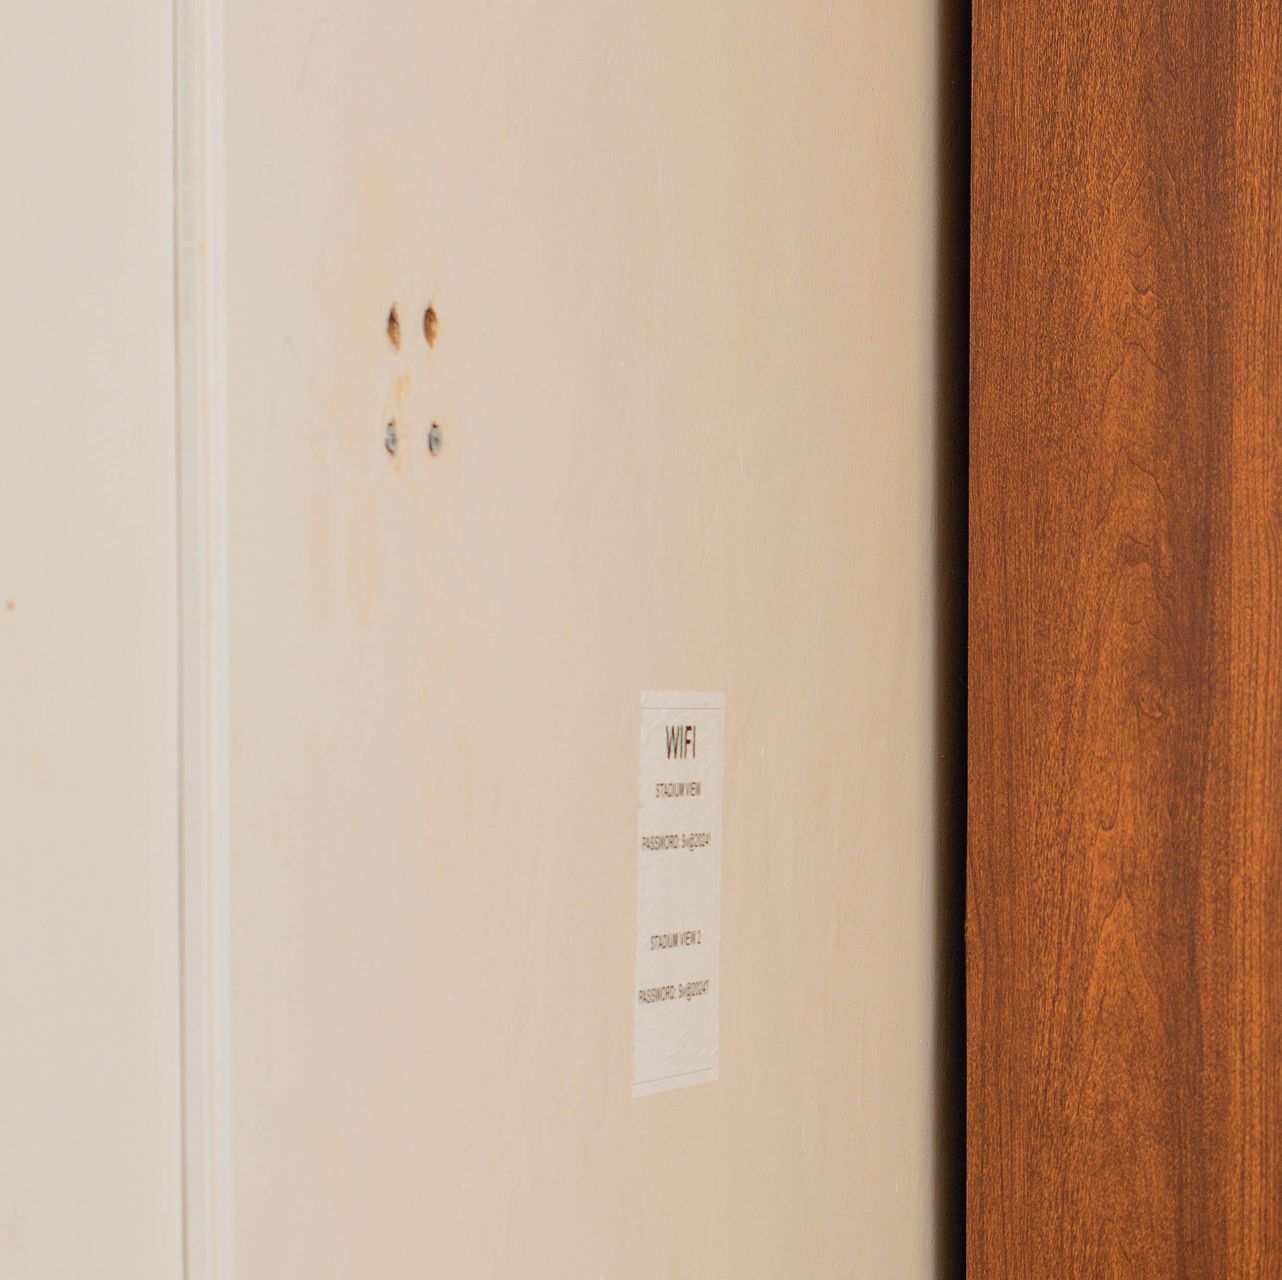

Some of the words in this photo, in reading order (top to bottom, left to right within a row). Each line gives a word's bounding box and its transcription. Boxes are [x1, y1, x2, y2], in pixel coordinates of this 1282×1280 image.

[665, 725, 696, 759] WIFI
[656, 782, 684, 798] STADIUM
[685, 782, 701, 796] VIEW
[650, 934, 678, 950] STADIUM
[680, 931, 696, 946] VIEW
[697, 930, 701, 944] 2
